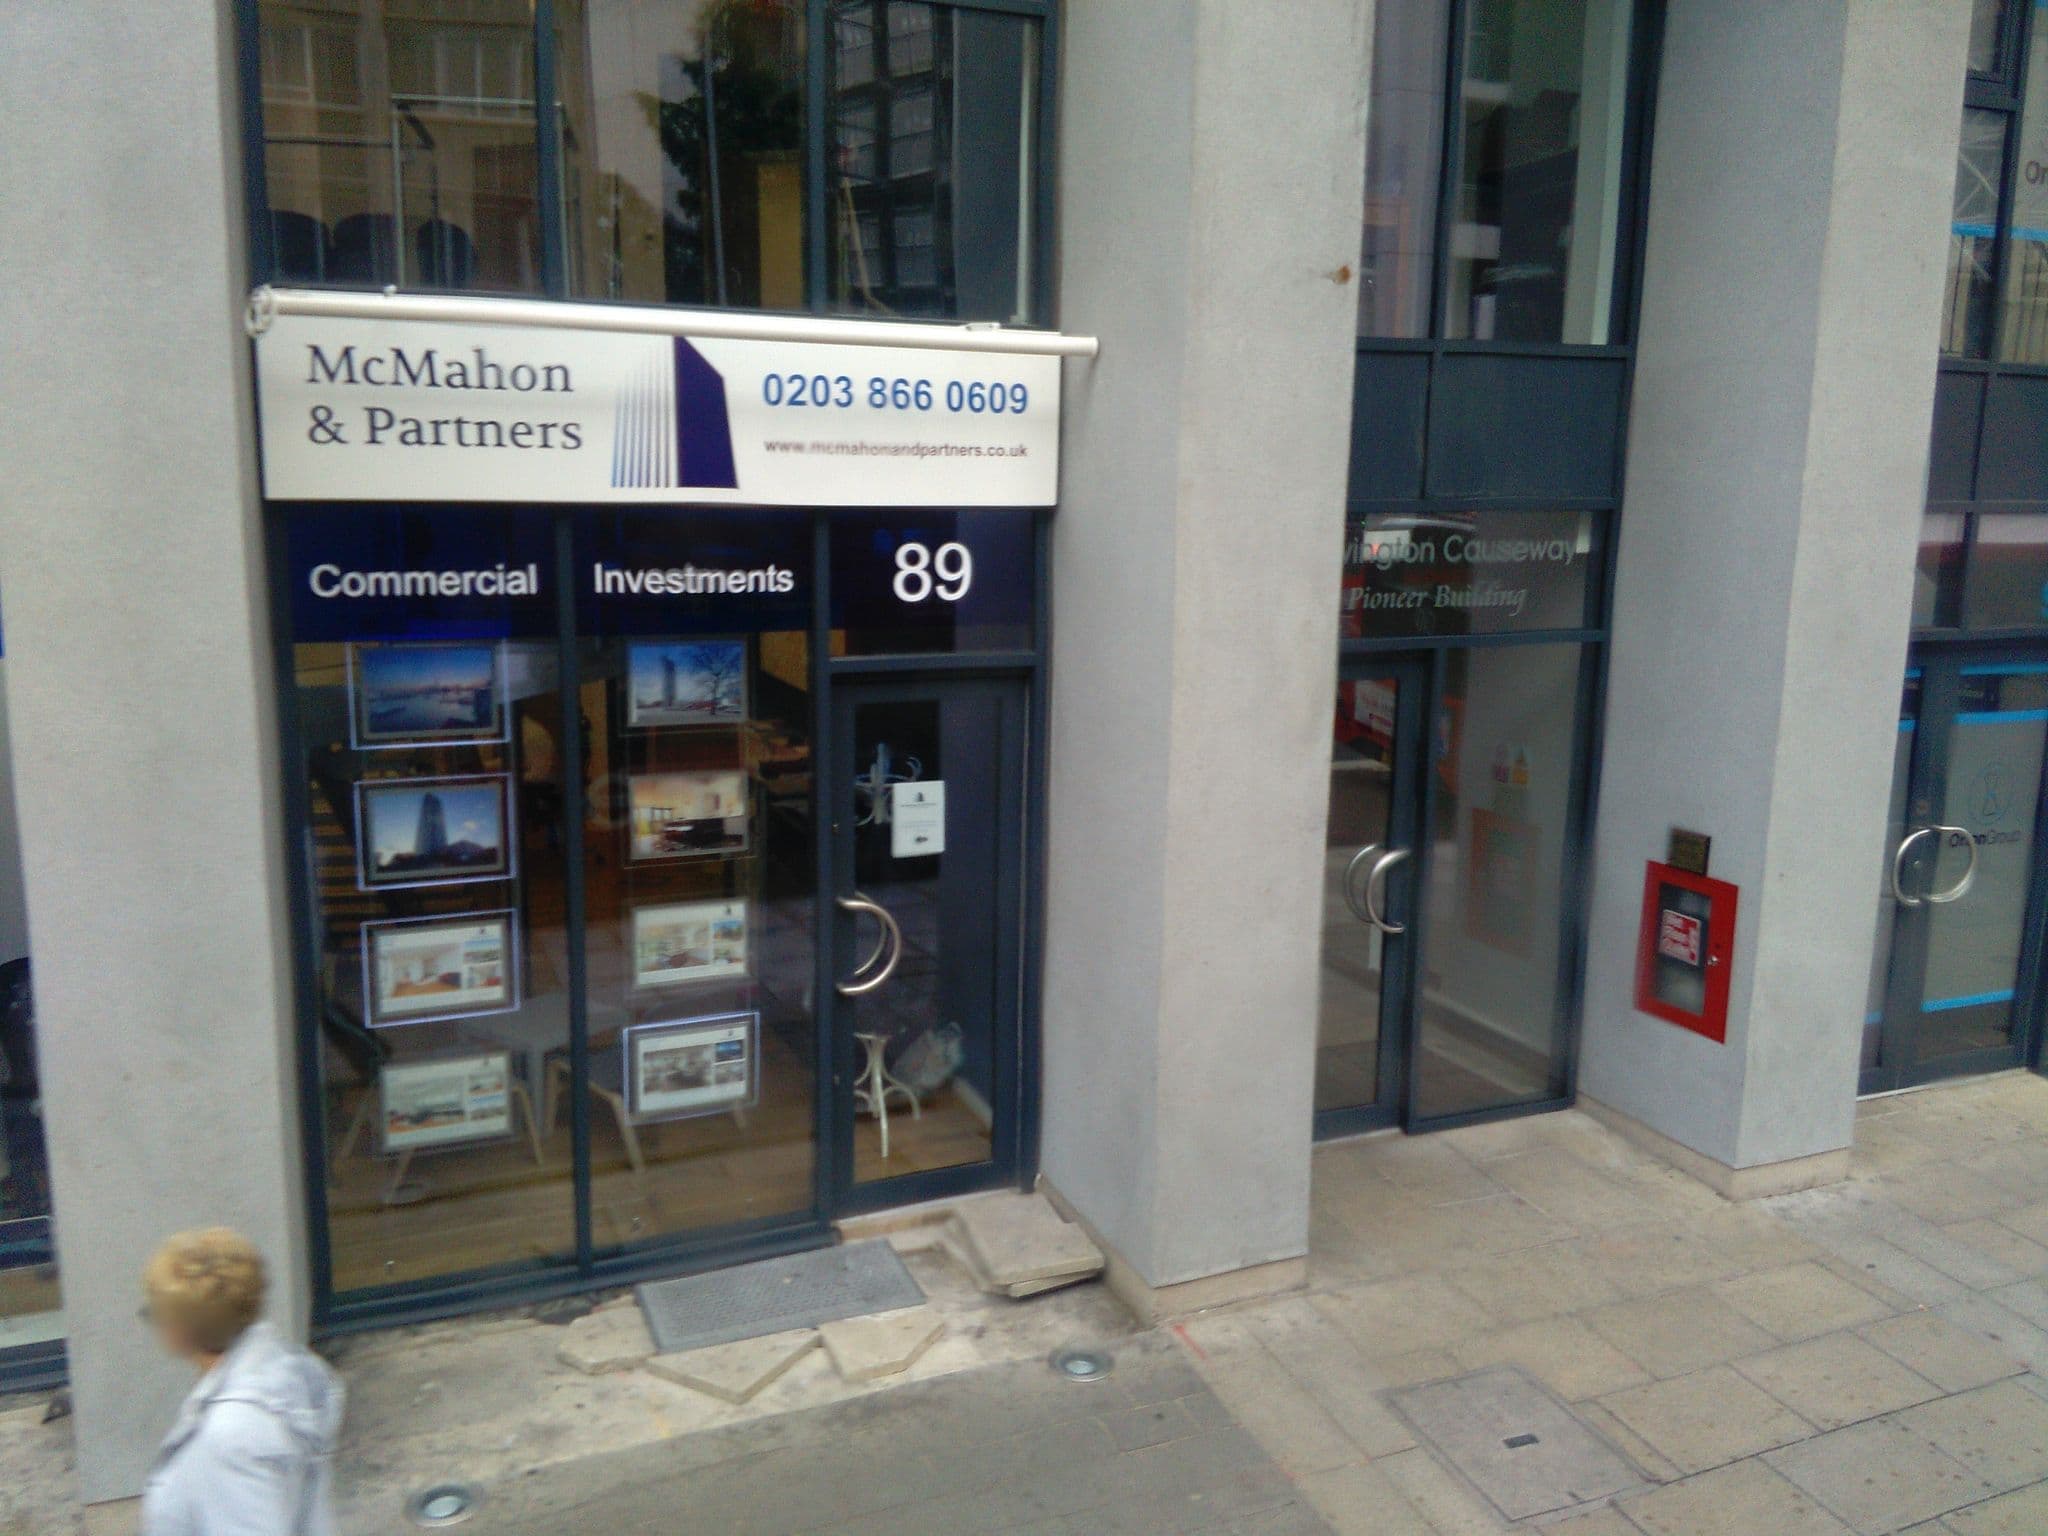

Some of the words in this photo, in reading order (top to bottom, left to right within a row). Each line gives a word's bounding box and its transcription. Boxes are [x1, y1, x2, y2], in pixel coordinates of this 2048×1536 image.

[306, 344, 574, 393] McMahon
[763, 373, 853, 408] 0203
[868, 377, 933, 411] 866
[946, 380, 1029, 414] 0609
[308, 405, 347, 445] &
[364, 406, 582, 450] Partners
[764, 438, 1029, 459] www.mcmahonandpartners.co.uk
[1443, 534, 1577, 565] Causeway
[309, 562, 538, 598] Commercial
[593, 561, 795, 596] Investments
[892, 541, 974, 603] 89
[1347, 586, 1430, 610] Pioneer
[1434, 585, 1528, 617] Building
